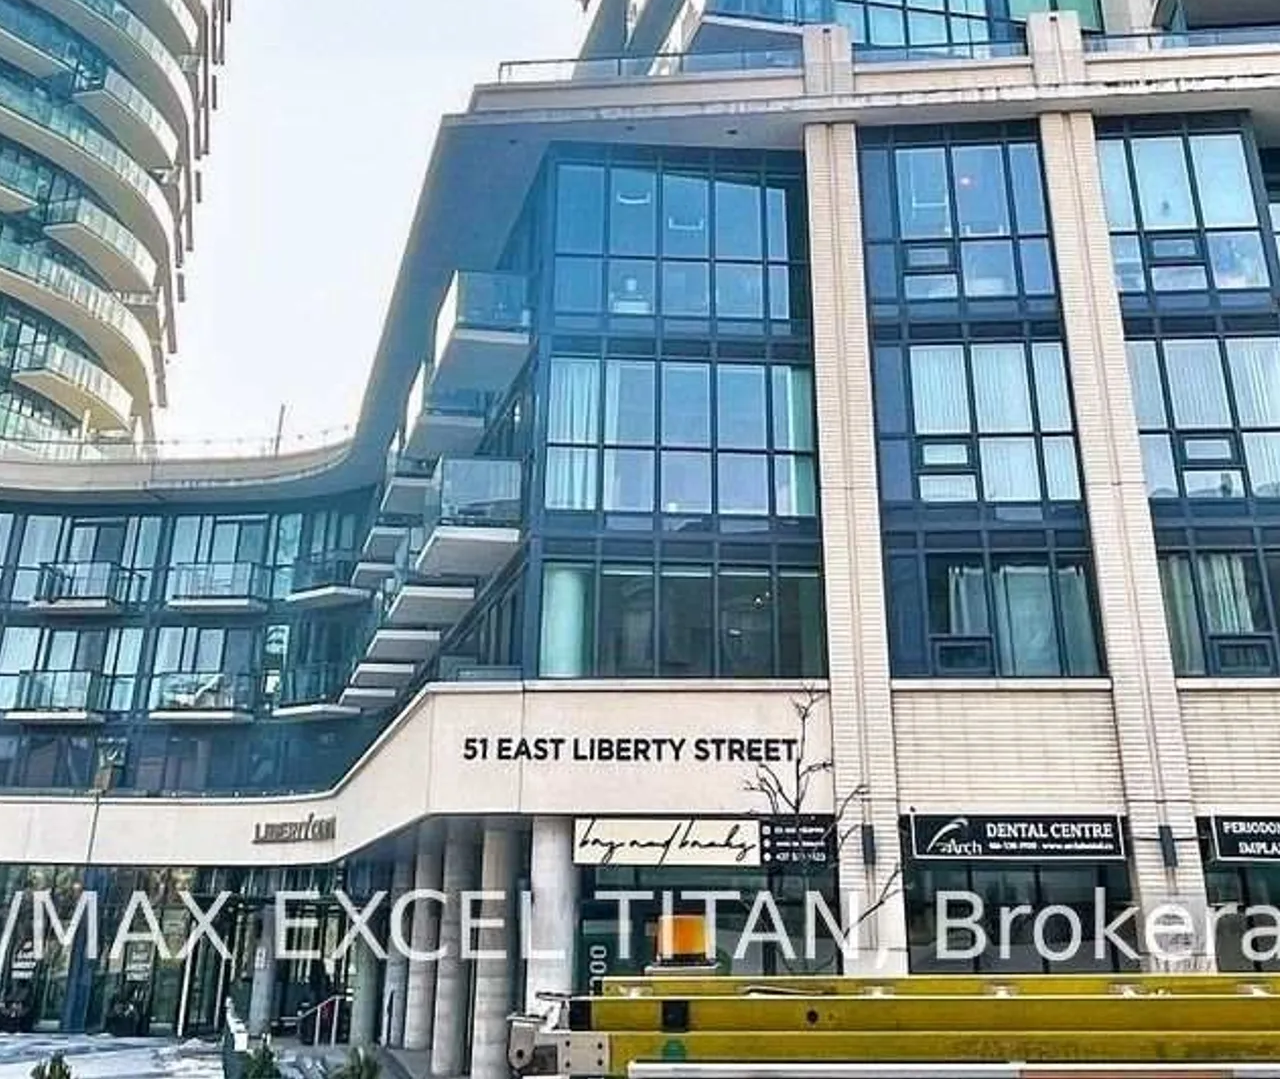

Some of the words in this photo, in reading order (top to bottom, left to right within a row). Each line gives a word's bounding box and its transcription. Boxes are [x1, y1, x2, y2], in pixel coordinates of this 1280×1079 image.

[463, 738, 489, 760] 51
[496, 738, 565, 761] EAST
[573, 738, 686, 761] LIBERTY
[694, 738, 799, 762] STREET
[986, 823, 1047, 838] DENTAL
[1050, 823, 1113, 838] CENTRE
